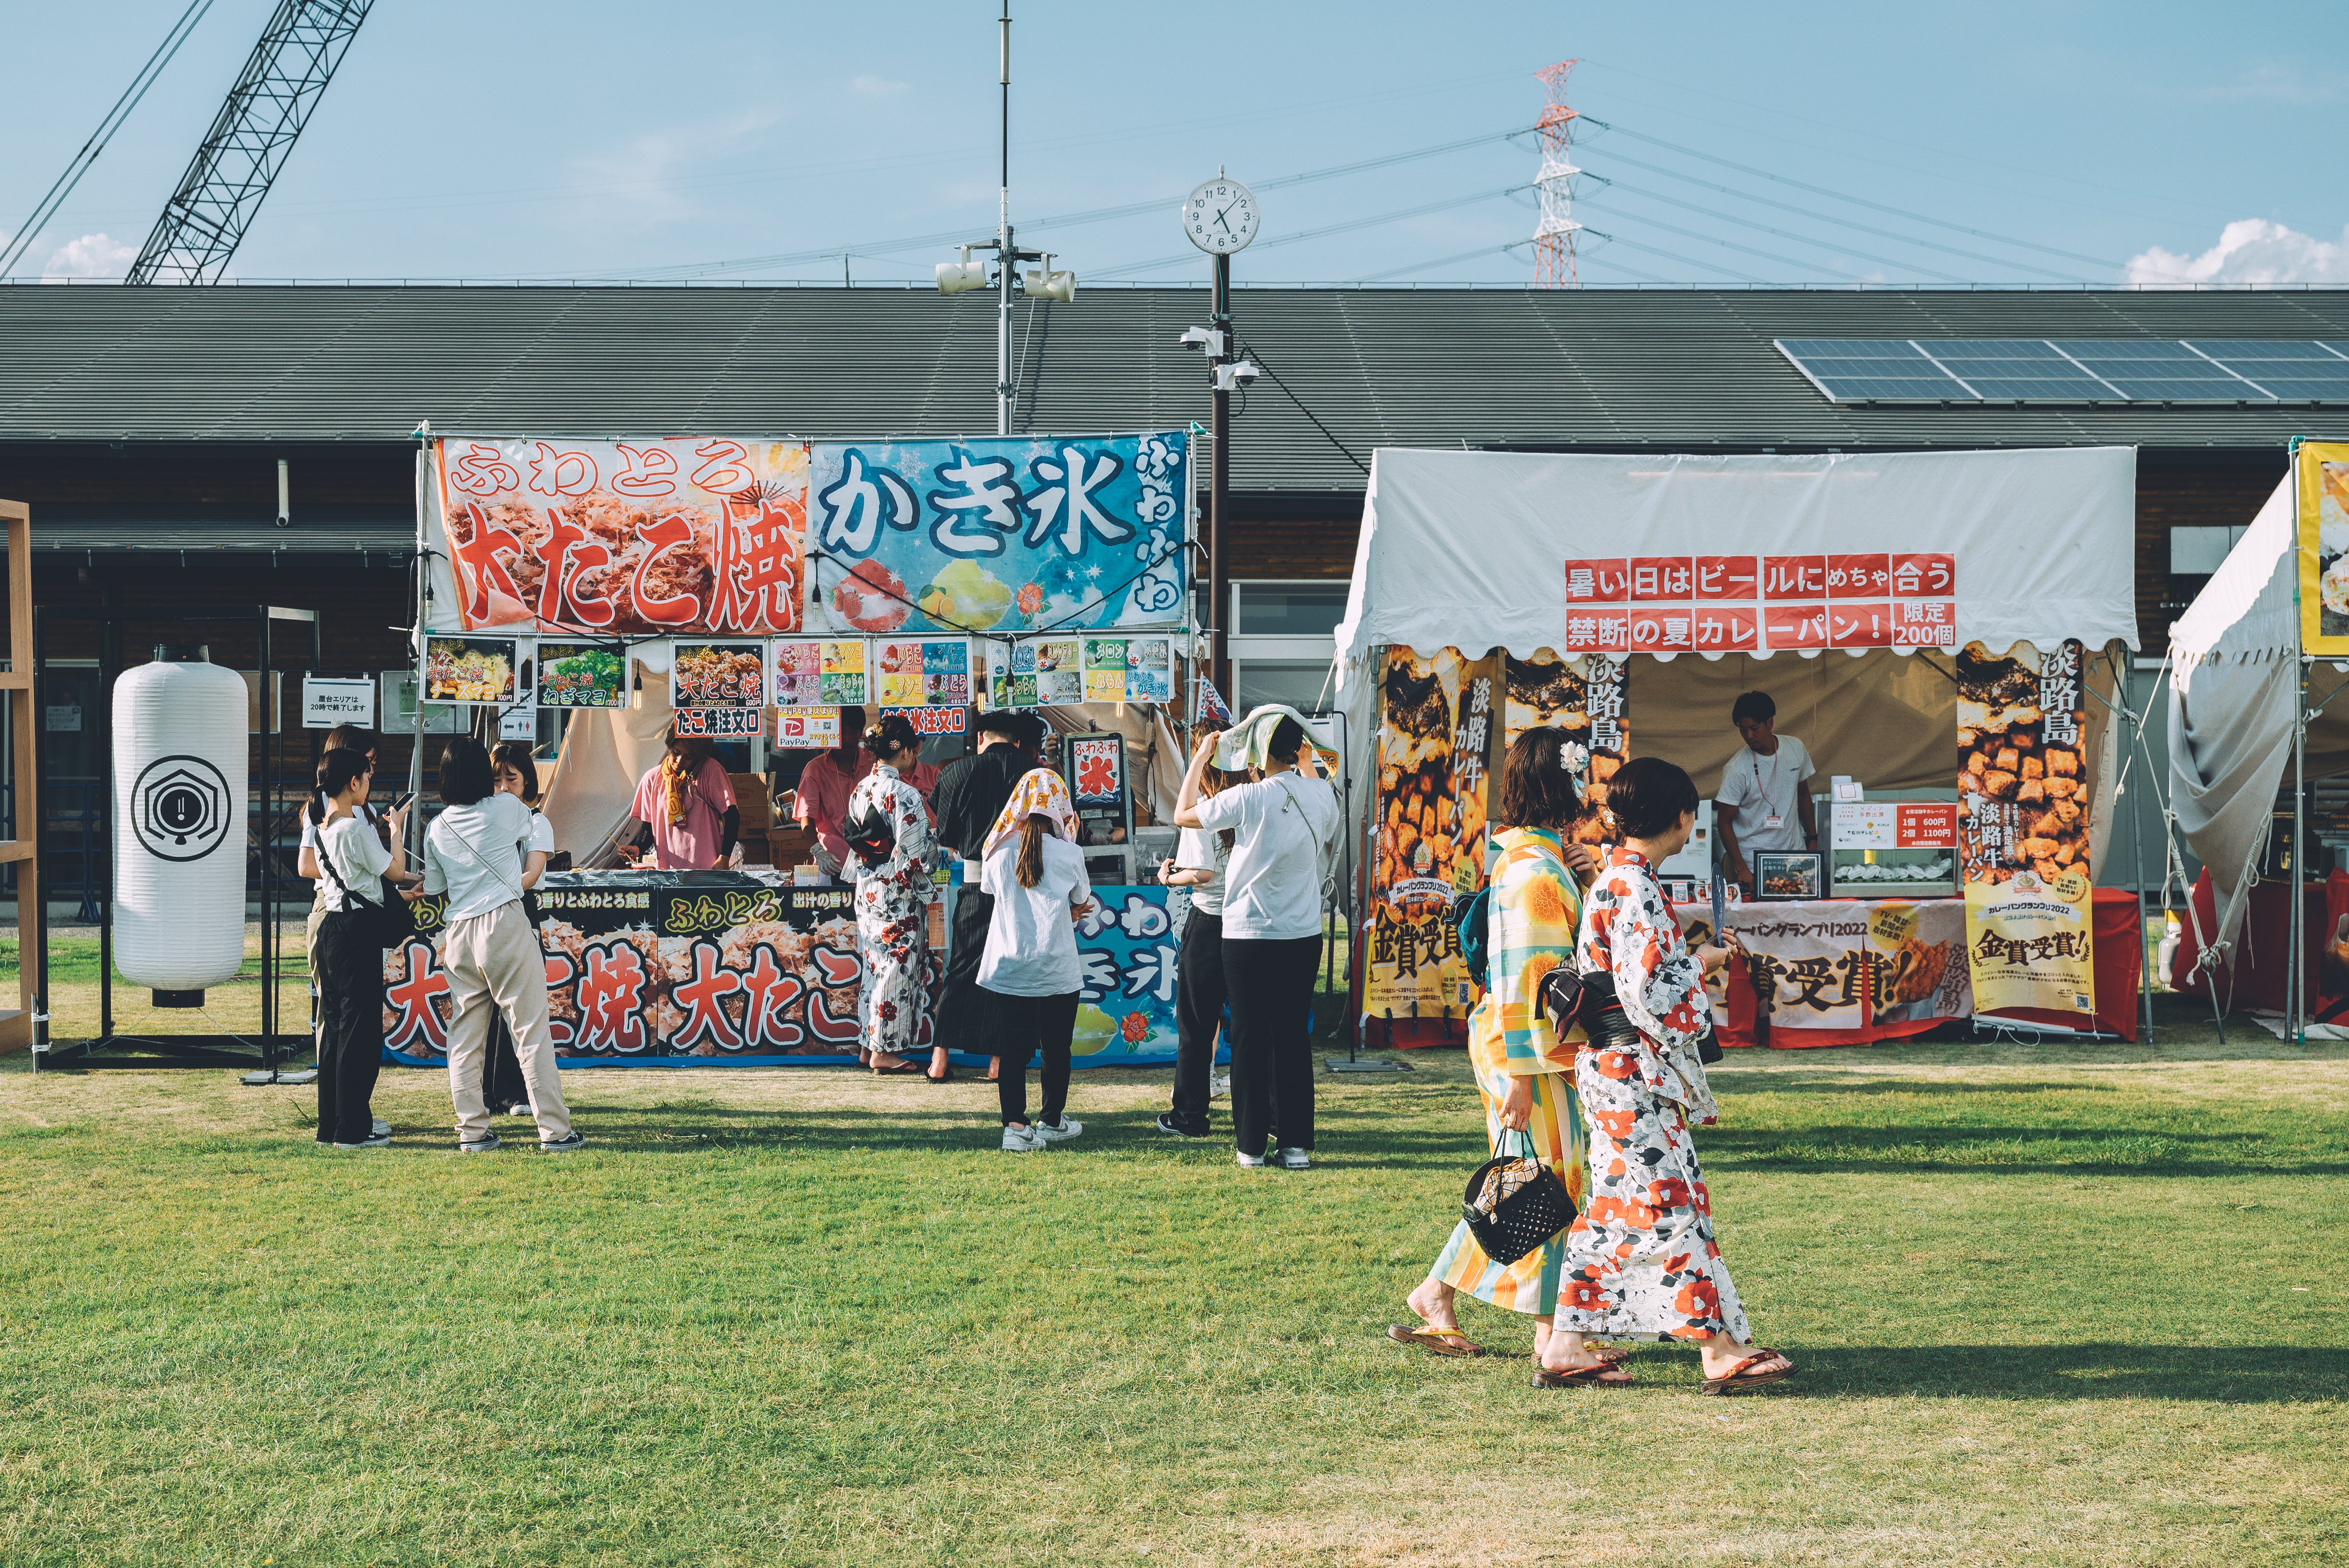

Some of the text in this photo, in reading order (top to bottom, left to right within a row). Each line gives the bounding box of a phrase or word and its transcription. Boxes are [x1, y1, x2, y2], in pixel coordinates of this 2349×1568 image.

[1206, 190, 1212, 198] 11
[1217, 187, 1226, 195] 12
[1233, 190, 1236, 198] 1
[1195, 199, 1205, 208] 10
[1241, 199, 1247, 208] 2
[1193, 212, 1199, 221] 9
[1244, 212, 1250, 221] 3
[1196, 225, 1202, 233] 8
[1240, 225, 1247, 234] 4
[1206, 235, 1211, 243] 7
[1218, 238, 1224, 246] 6
[1231, 235, 1237, 243] 5
[450, 440, 755, 497] ふわとろ
[818, 441, 1136, 561] かき氷
[1133, 438, 1180, 612] ふわふわ
[456, 498, 795, 632] 大たこ焼
[1567, 562, 1950, 597] 暑い日はビールにめちゃ合う
[1904, 603, 1945, 623] 限定
[1895, 625, 1954, 646] 200個
[429, 639, 465, 652] ふわとろ
[540, 645, 575, 658] ふわとろ
[678, 647, 714, 659] ふわとろ
[794, 643, 820, 658] いちご
[838, 643, 863, 659] マンゴ
[938, 644, 965, 654] ブルー
[1047, 643, 1078, 659] ミルクティー
[1097, 643, 1124, 659] メロン
[1145, 642, 1167, 659] みぞれ
[898, 644, 922, 665] いちご
[942, 653, 965, 664] ハワイ
[1011, 645, 1036, 665] カルピス
[800, 659, 819, 669] ミルク
[841, 659, 863, 668] ミルク
[427, 665, 484, 682] 大たこ焼
[538, 671, 594, 687] 大たこ焼
[1052, 674, 1076, 684] みぞれ
[1096, 672, 1124, 689] れもん
[1127, 671, 1155, 682] ふわふわ
[678, 672, 761, 699] 大たこ焼
[796, 675, 820, 690] ぶどう
[839, 674, 863, 689] まっちゃ
[897, 675, 923, 695] マンゴ
[941, 674, 967, 692] ぶどう
[1057, 682, 1079, 691] ミルク
[1137, 682, 1168, 694] かき氷
[430, 682, 497, 701] チーズマヨ
[543, 688, 607, 705] ねぎマヨ
[797, 689, 820, 701] カルピス
[842, 689, 863, 697] ミルク
[2039, 643, 2079, 745] 淡路島
[311, 704, 366, 712] 20時で終了します
[1586, 654, 1624, 752] 淡路島
[676, 709, 760, 736] たこ焼注文口
[780, 738, 810, 747] PayPay
[1465, 677, 1491, 793] 淡路牛
[1075, 741, 1118, 756] ふわふわ
[1079, 756, 1115, 795] 氷
[1449, 724, 1470, 847] カレーパン
[1903, 818, 1946, 826] 1個 600円
[1924, 829, 1950, 837] 1100円
[1980, 803, 2004, 869] 淡路牛
[1966, 816, 1983, 882] カレーパン
[1396, 881, 1448, 895] カレーパングランプリ2022
[792, 892, 852, 909] 出汁の香り
[665, 889, 782, 933] ふわとろ
